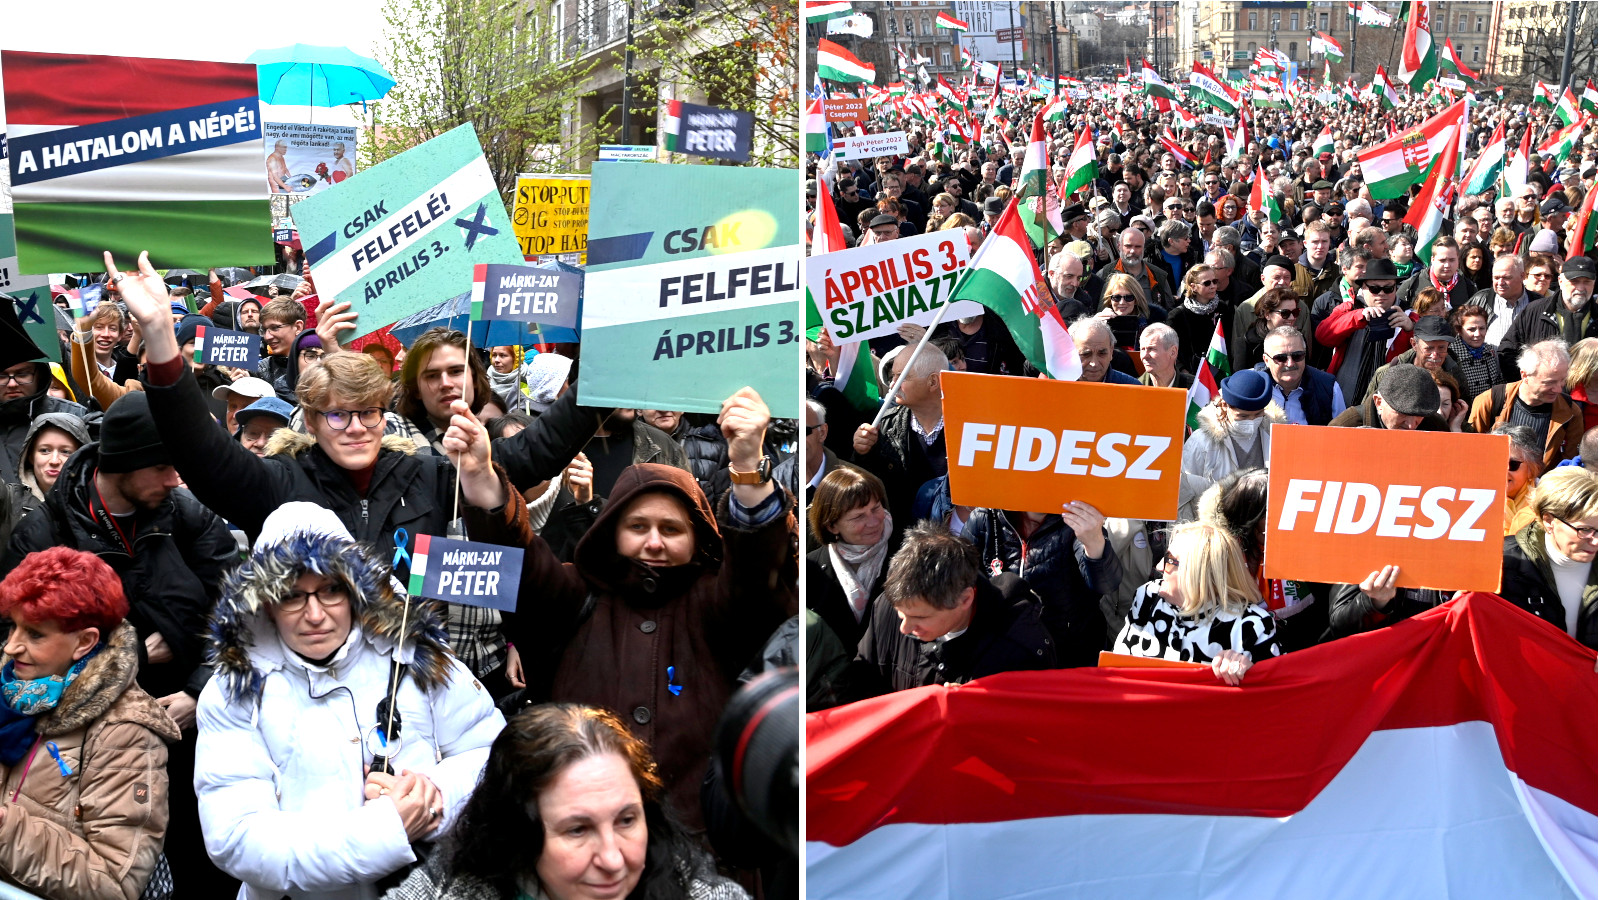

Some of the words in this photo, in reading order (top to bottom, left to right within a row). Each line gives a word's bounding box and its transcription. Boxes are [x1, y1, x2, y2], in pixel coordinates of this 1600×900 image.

[18, 150, 38, 174] A
[42, 126, 162, 169] HATALOM
[168, 123, 186, 146] A
[189, 106, 256, 140] NÉPÉ!
[266, 124, 286, 132] Engedd
[518, 186, 590, 204] STOP-PUT
[343, 199, 389, 239] CSAK
[554, 208, 570, 216] STOP
[351, 192, 451, 272] FELFELÉ!
[516, 236, 554, 254] STOP
[560, 229, 587, 251] HÁB
[664, 222, 742, 254] CSAK
[364, 248, 430, 304] ÁPRILIS
[434, 240, 450, 258] 3.
[500, 273, 560, 288] MÁRKI-ZAY
[659, 260, 799, 308] FELFEL
[825, 248, 933, 309] ÁPRILIS
[938, 240, 966, 271] 3.
[497, 288, 558, 316] PÉTER
[830, 269, 966, 338] SZAVAZZ
[211, 344, 248, 362] PÉTER
[213, 333, 249, 345] MÁRKI-ZAY
[653, 323, 770, 361] ÁPRILIS
[777, 320, 799, 344] 3.
[958, 422, 1172, 480] FIDESZ
[1278, 478, 1496, 542] FIDESZ
[443, 549, 502, 566] MÁRKI-ZAY
[437, 566, 500, 596] PÉTER
